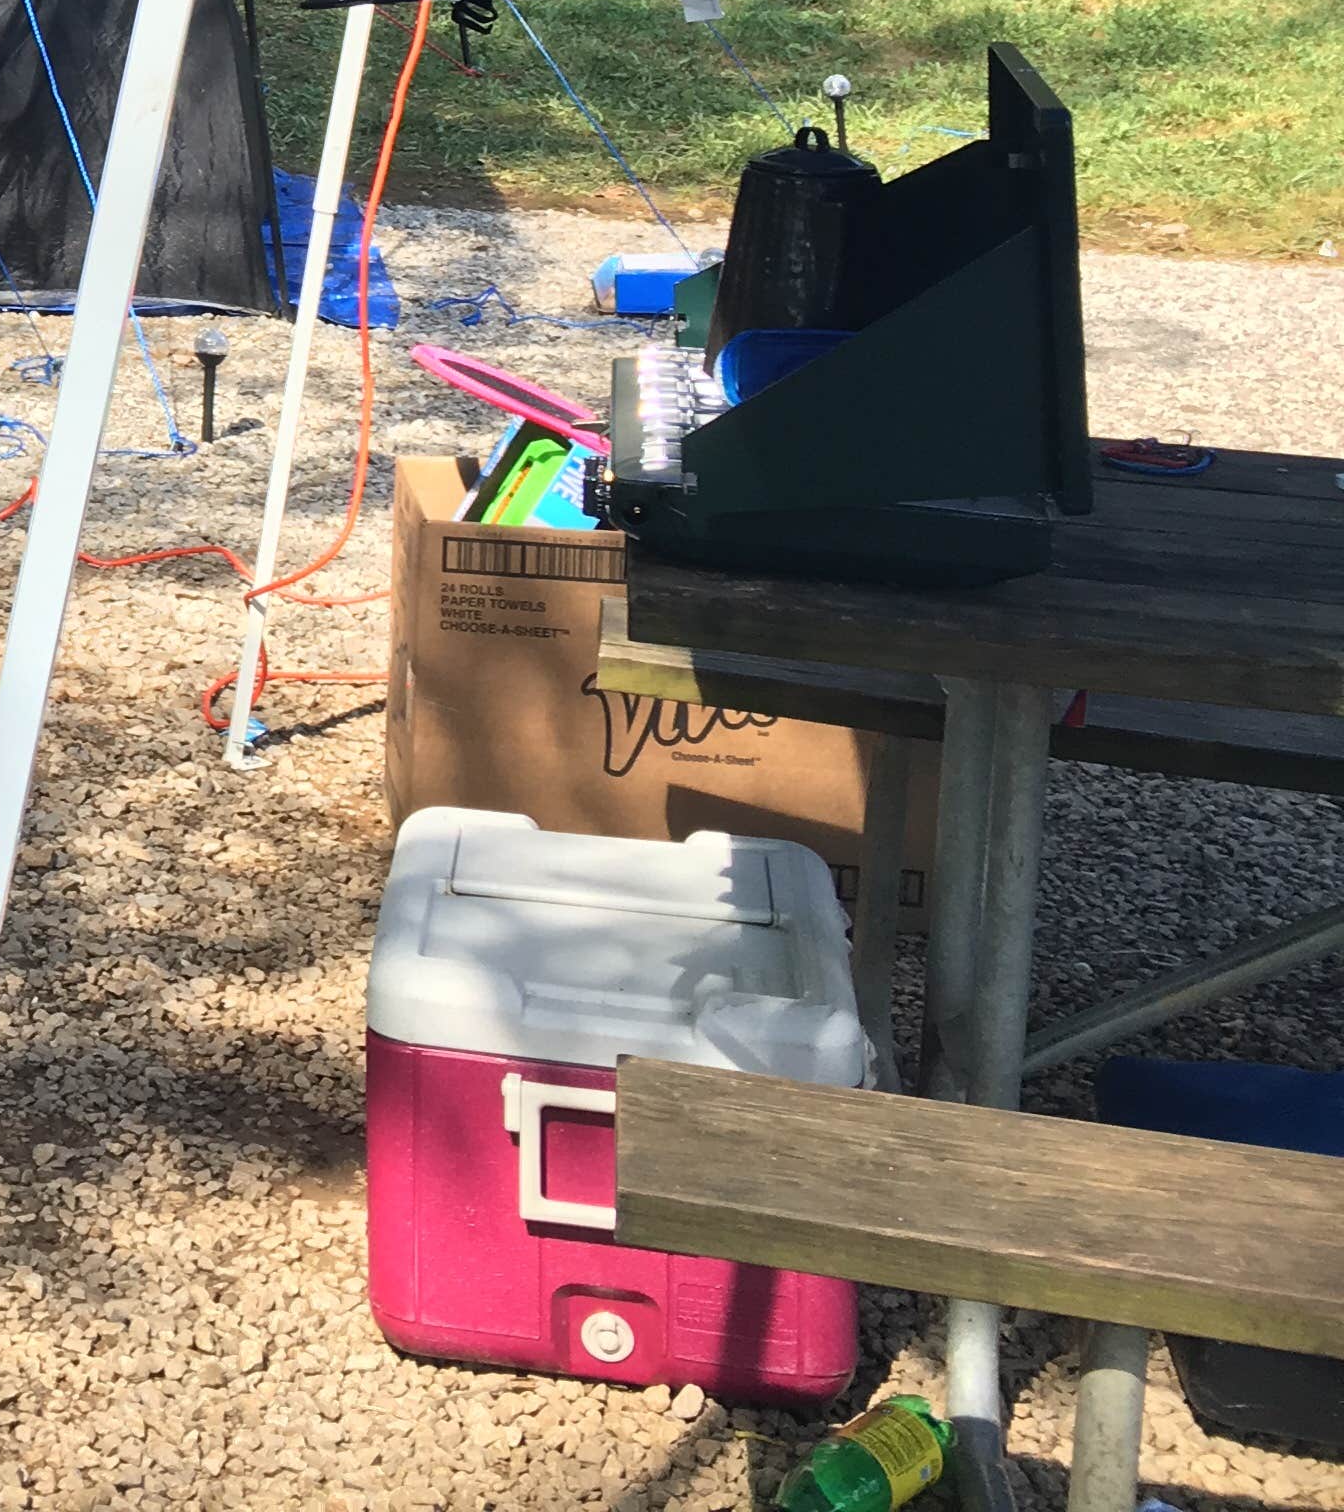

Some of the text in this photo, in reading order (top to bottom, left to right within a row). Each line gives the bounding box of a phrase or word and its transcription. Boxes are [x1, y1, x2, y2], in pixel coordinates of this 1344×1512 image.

[440, 583, 504, 596] 24 ROLLS
[441, 595, 546, 613] PAPER TOWELS
[441, 607, 483, 620] WHITE
